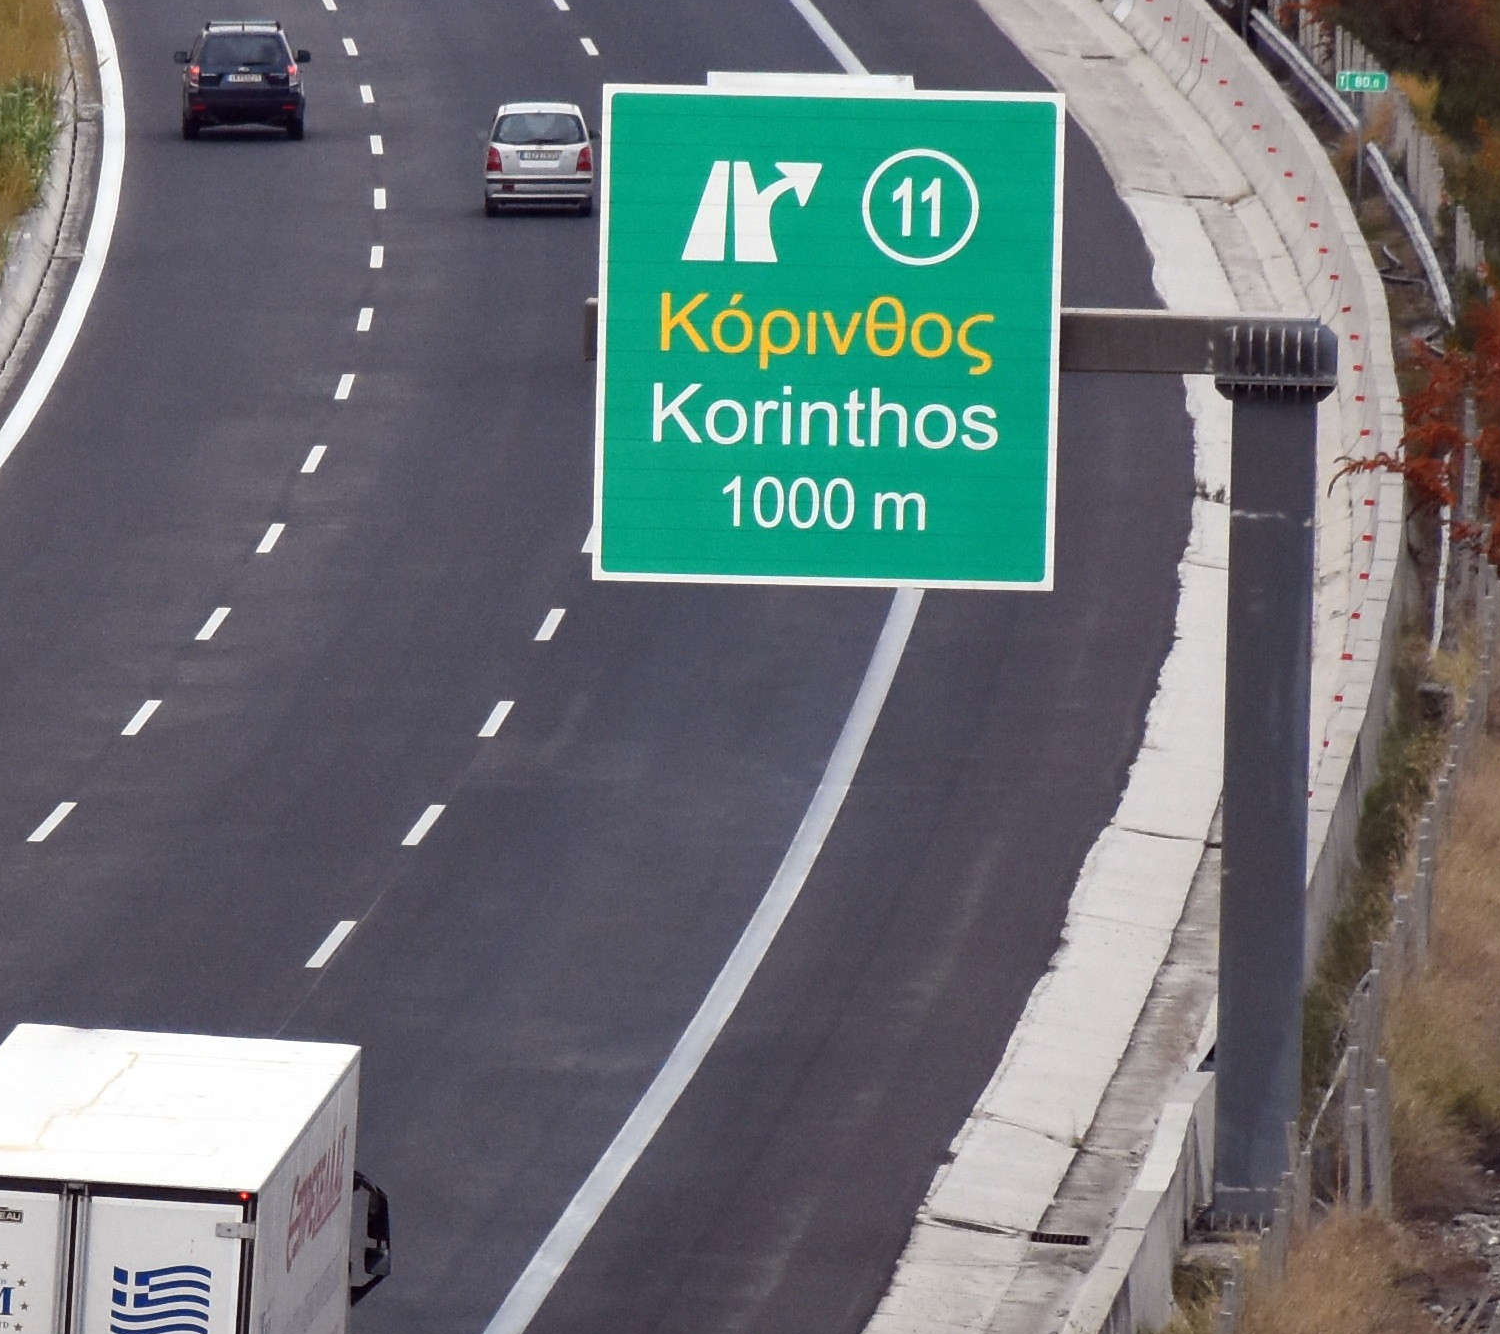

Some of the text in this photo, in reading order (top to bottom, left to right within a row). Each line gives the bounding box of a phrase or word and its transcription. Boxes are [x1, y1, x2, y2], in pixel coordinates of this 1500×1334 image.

[891, 176, 943, 238] 11
[660, 292, 995, 376] Κόρινθος
[653, 382, 999, 451] Korinthos
[722, 475, 926, 531] 1000 m
